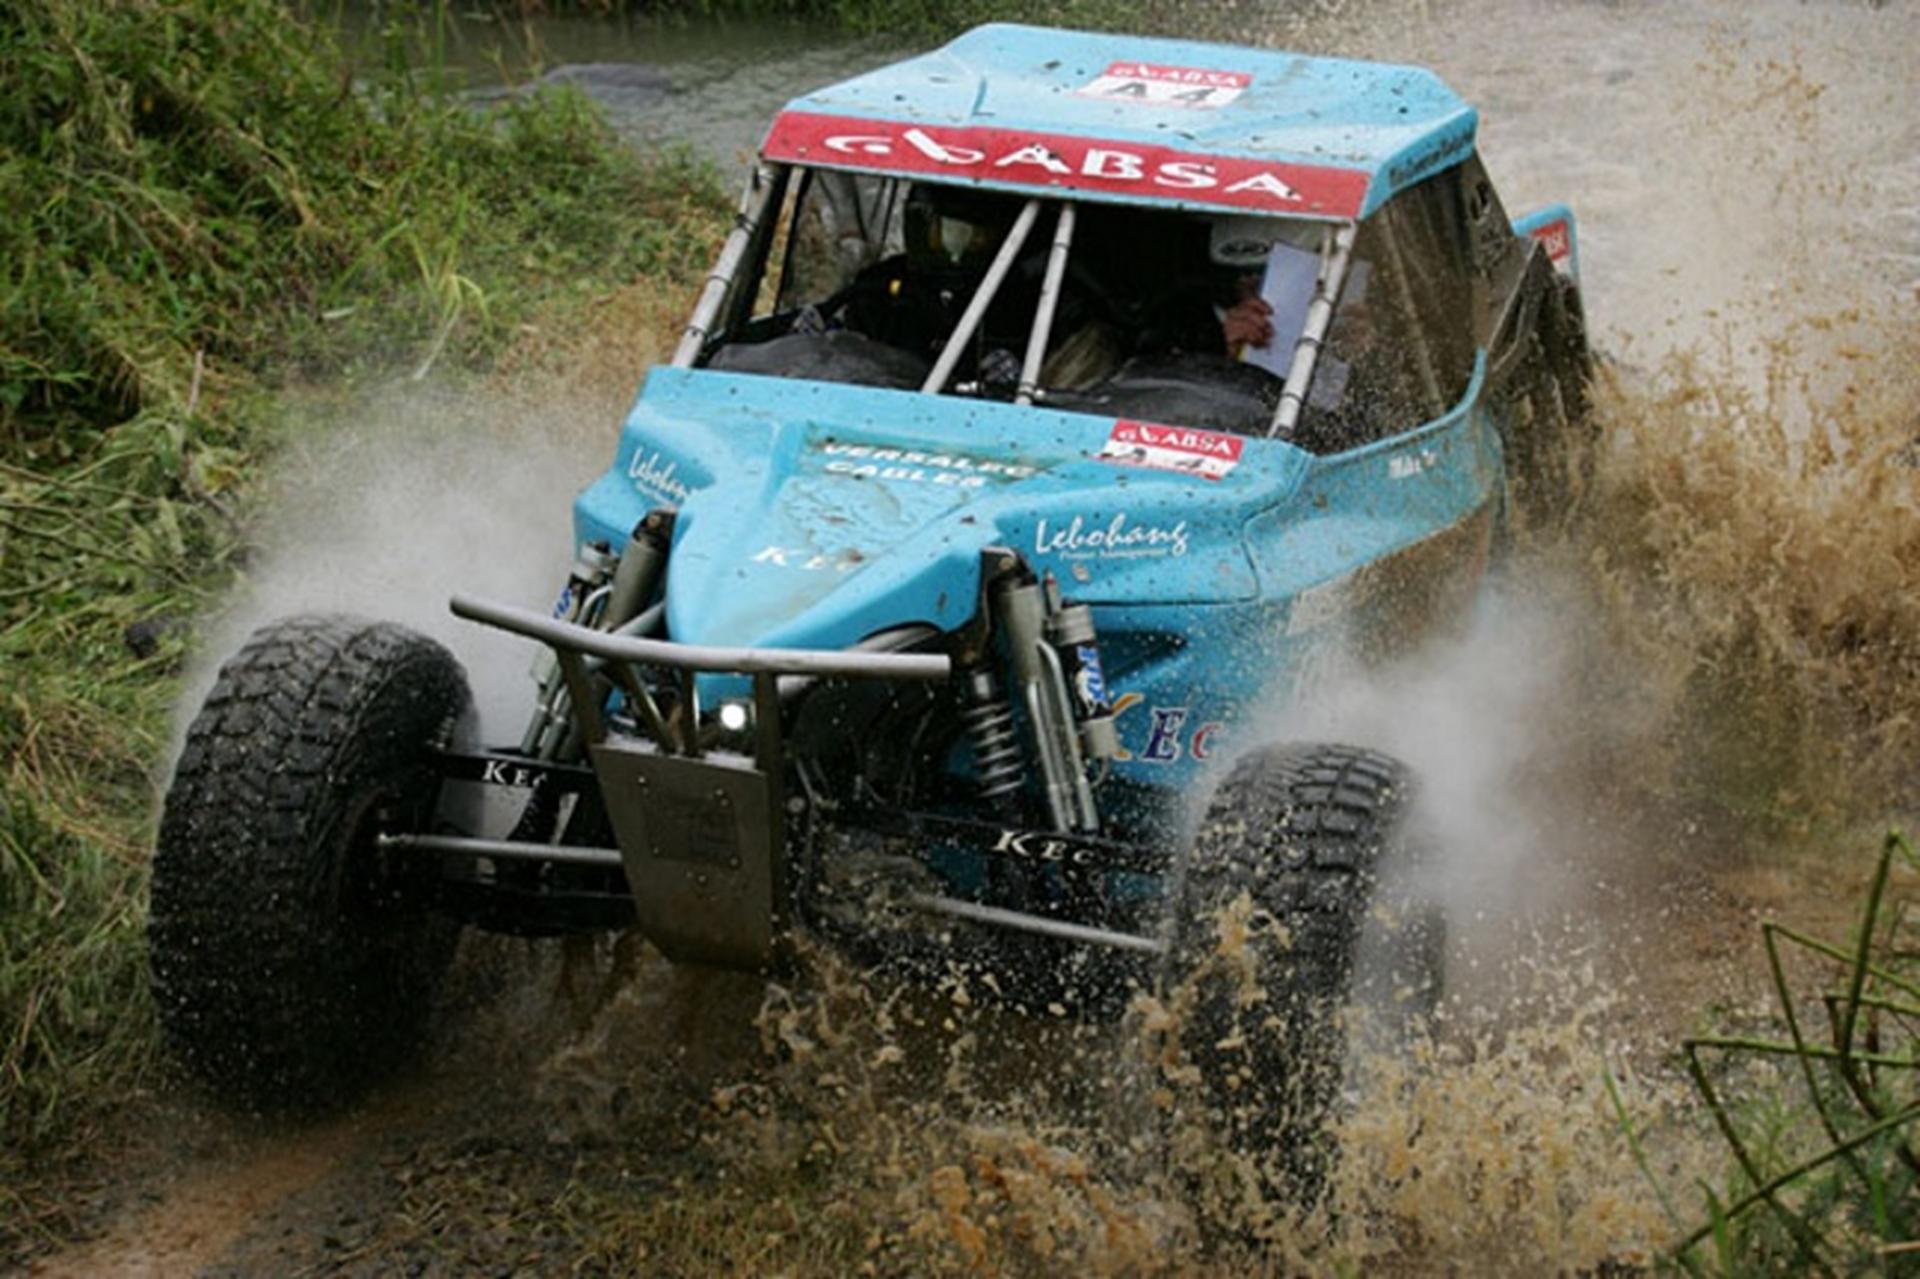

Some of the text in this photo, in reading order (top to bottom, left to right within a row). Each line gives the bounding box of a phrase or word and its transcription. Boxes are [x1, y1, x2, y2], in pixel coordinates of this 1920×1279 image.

[996, 142, 1302, 200] ABSA
[1160, 431, 1232, 456] ABSA
[1035, 512, 1188, 557] Lebohang
[991, 830, 1096, 864] KEC
